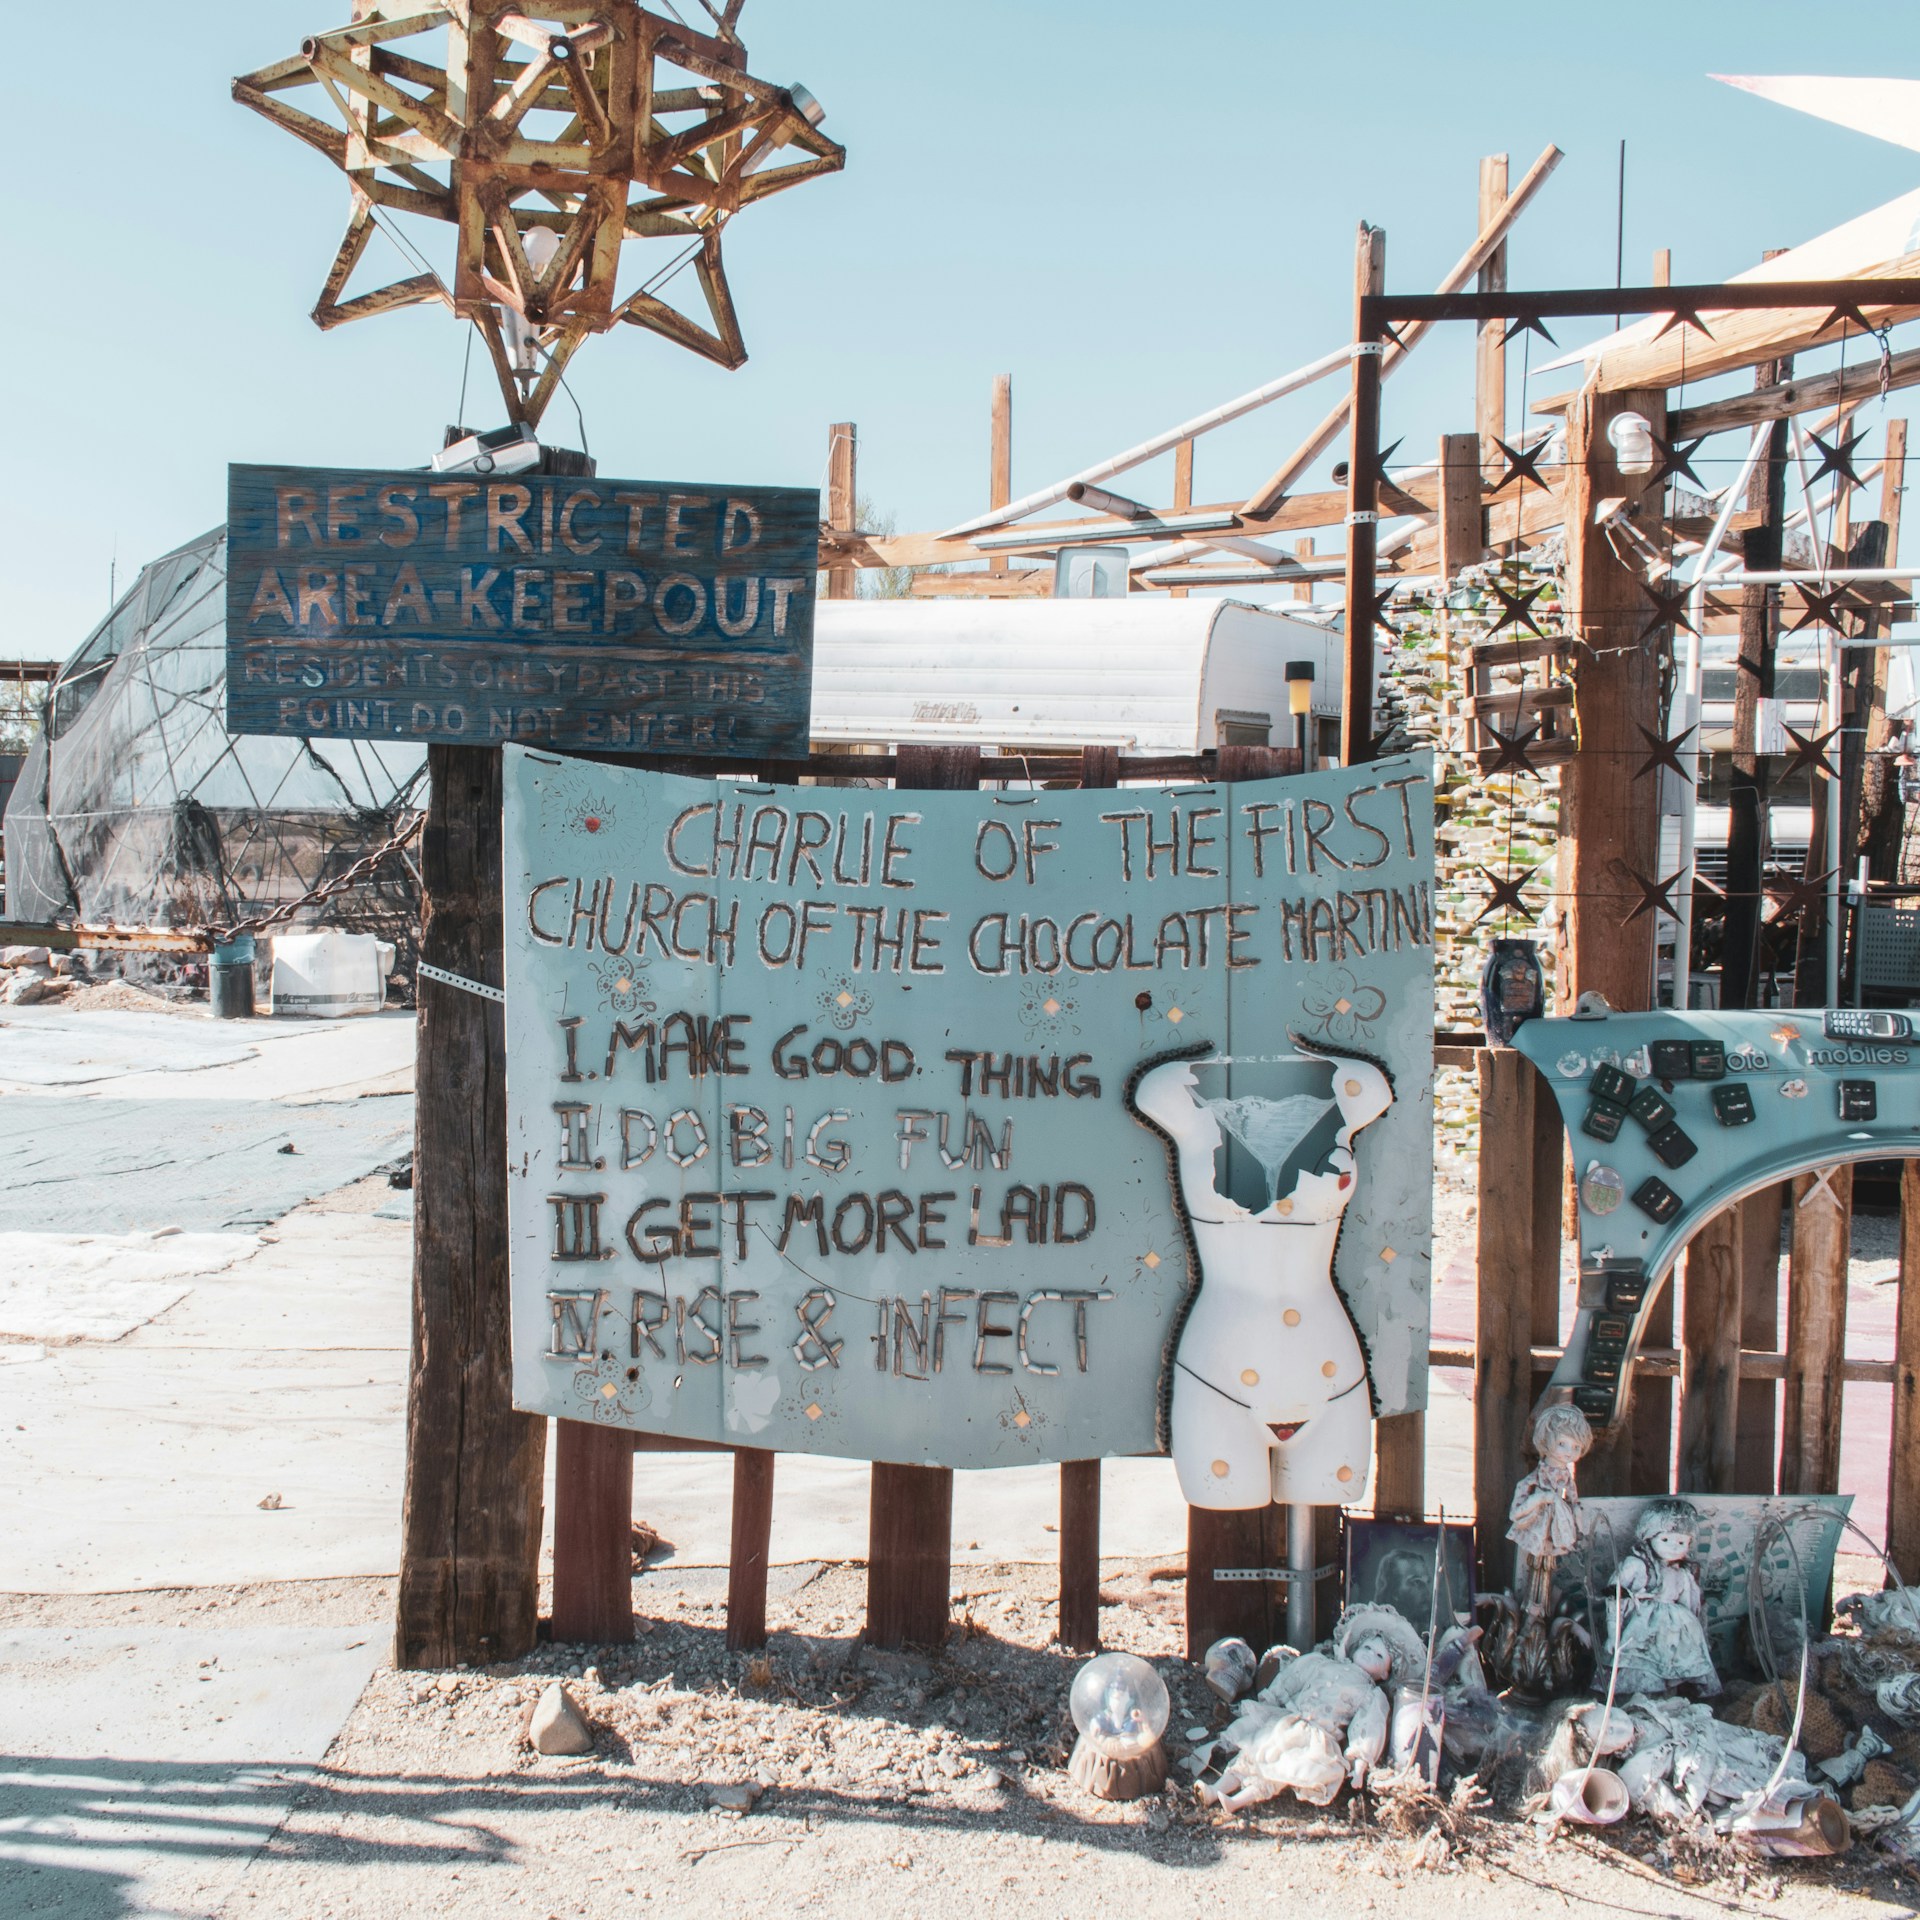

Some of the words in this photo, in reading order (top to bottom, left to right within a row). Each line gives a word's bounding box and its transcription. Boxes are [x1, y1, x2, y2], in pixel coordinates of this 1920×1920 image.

[274, 482, 762, 558] RESTRICTED
[245, 652, 457, 688] RESIDENTS
[468, 658, 568, 694] ONLY
[576, 663, 676, 698] PAST
[689, 669, 766, 703] THIS
[411, 702, 466, 735] DO
[489, 707, 566, 740] NOT
[664, 799, 924, 889] CHARLIE
[974, 817, 1062, 885] OF
[1099, 805, 1223, 882] THE
[1241, 774, 1428, 878] FIRST
[527, 873, 740, 968] CHURCH
[757, 898, 837, 970] OF
[843, 903, 951, 975] THE
[968, 901, 1262, 976] CHOCOLATE
[1280, 880, 1431, 963] MARTINI
[772, 1023, 916, 1083] GOOD
[945, 1050, 1101, 1100] THING
[1807, 1046, 1909, 1065] mobiles
[619, 1106, 710, 1171] DO
[730, 1103, 852, 1173] BIG
[894, 1107, 1013, 1172] FUN
[625, 1190, 777, 1263] GET
[778, 1188, 957, 1257] MORE
[969, 1182, 1097, 1247] LAID
[631, 1285, 769, 1369] RISE
[792, 1287, 844, 1373] &
[877, 1288, 1115, 1377] INFECT
